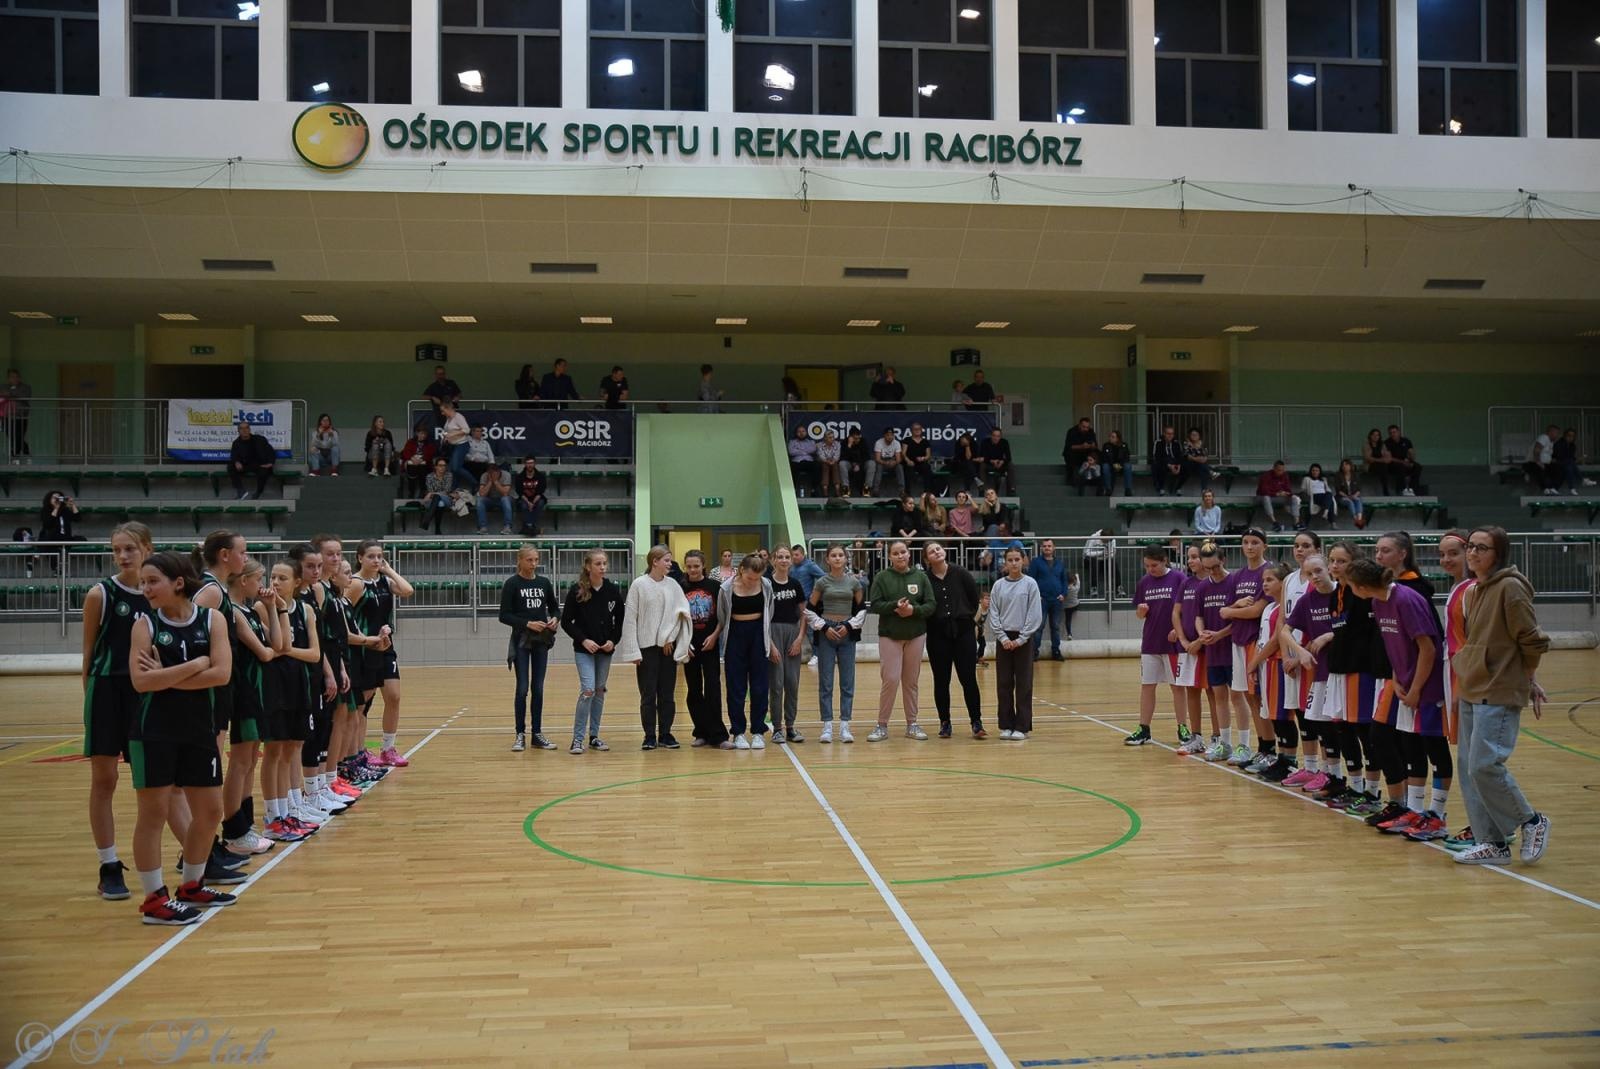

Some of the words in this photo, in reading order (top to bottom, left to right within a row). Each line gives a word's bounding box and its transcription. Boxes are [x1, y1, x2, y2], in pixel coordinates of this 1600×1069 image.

[382, 113, 548, 152] OŚRODEK
[563, 121, 699, 155] SPORTU
[712, 126, 719, 156] I
[734, 127, 911, 161] REKREACJI
[925, 128, 1083, 165] RACIBÓRZ
[555, 420, 611, 440] OSiR
[577, 439, 612, 447] RACIBÓRZ
[520, 588, 545, 598] WEEK
[526, 598, 542, 608] END
[180, 640, 188, 661] 1
[211, 757, 218, 778] 1
